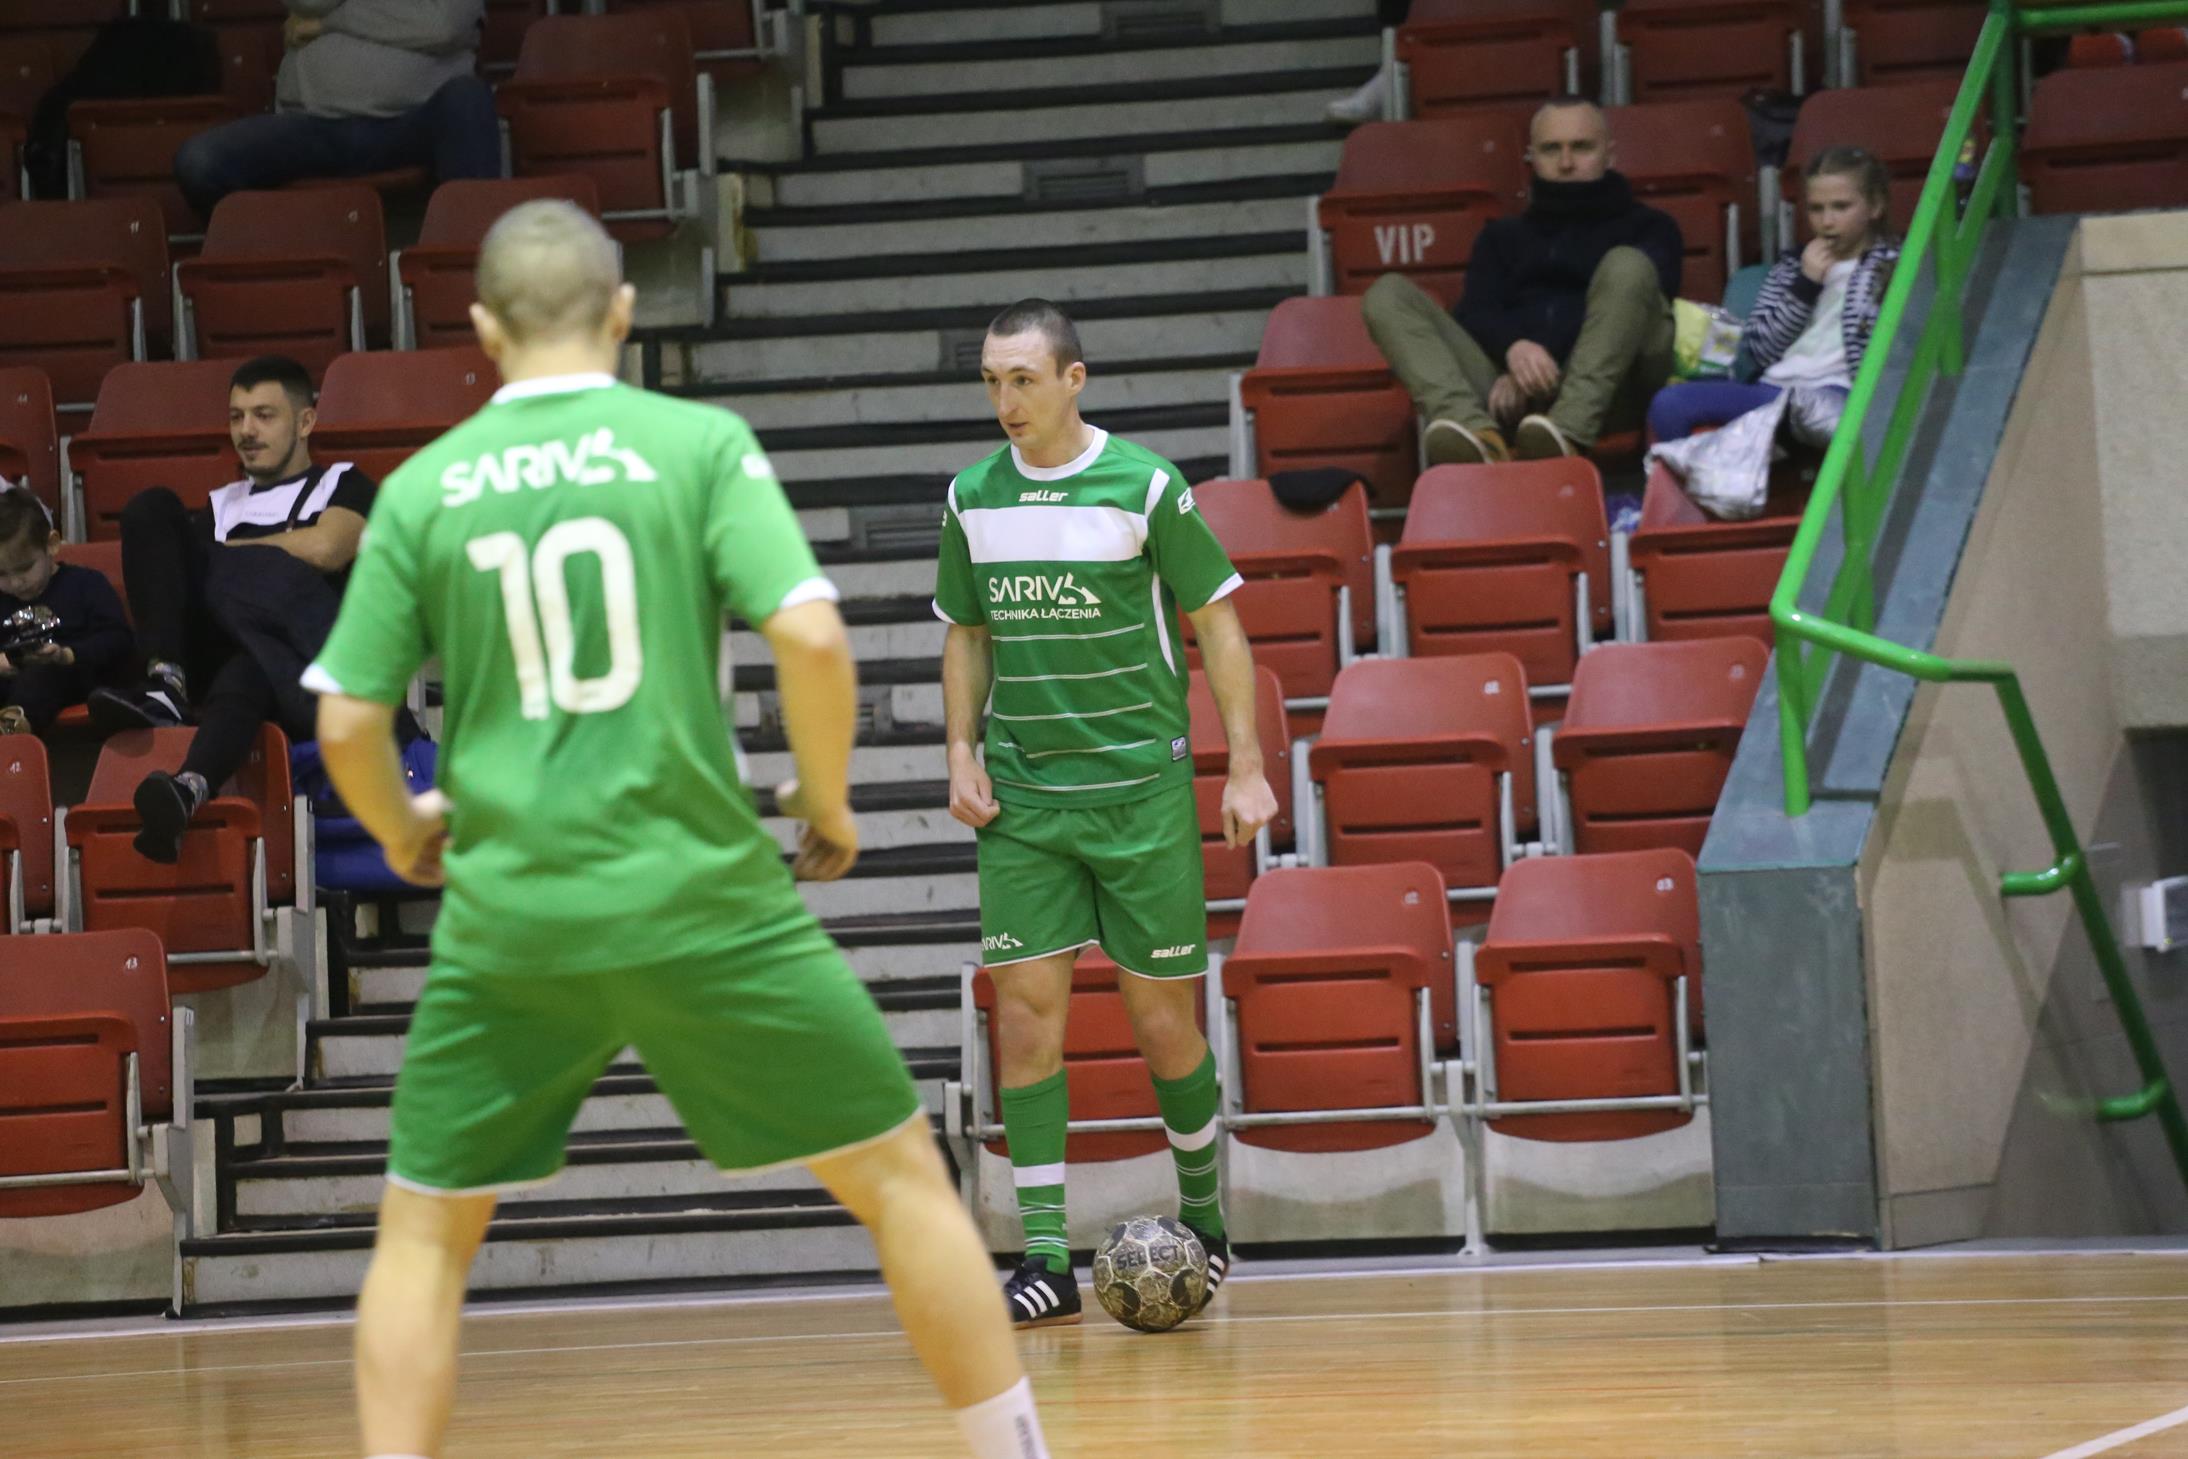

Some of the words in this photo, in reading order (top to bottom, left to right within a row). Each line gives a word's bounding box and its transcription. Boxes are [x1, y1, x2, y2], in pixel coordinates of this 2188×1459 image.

[1374, 224, 1435, 265] VIP
[1018, 489, 1069, 503] saller
[465, 516, 644, 720] 10
[990, 608, 1039, 621] TECHNIKA
[1040, 607, 1101, 621] ŁĄCZENIA
[1151, 943, 1196, 959] saller
[1116, 1244, 1178, 1270] SELECT
